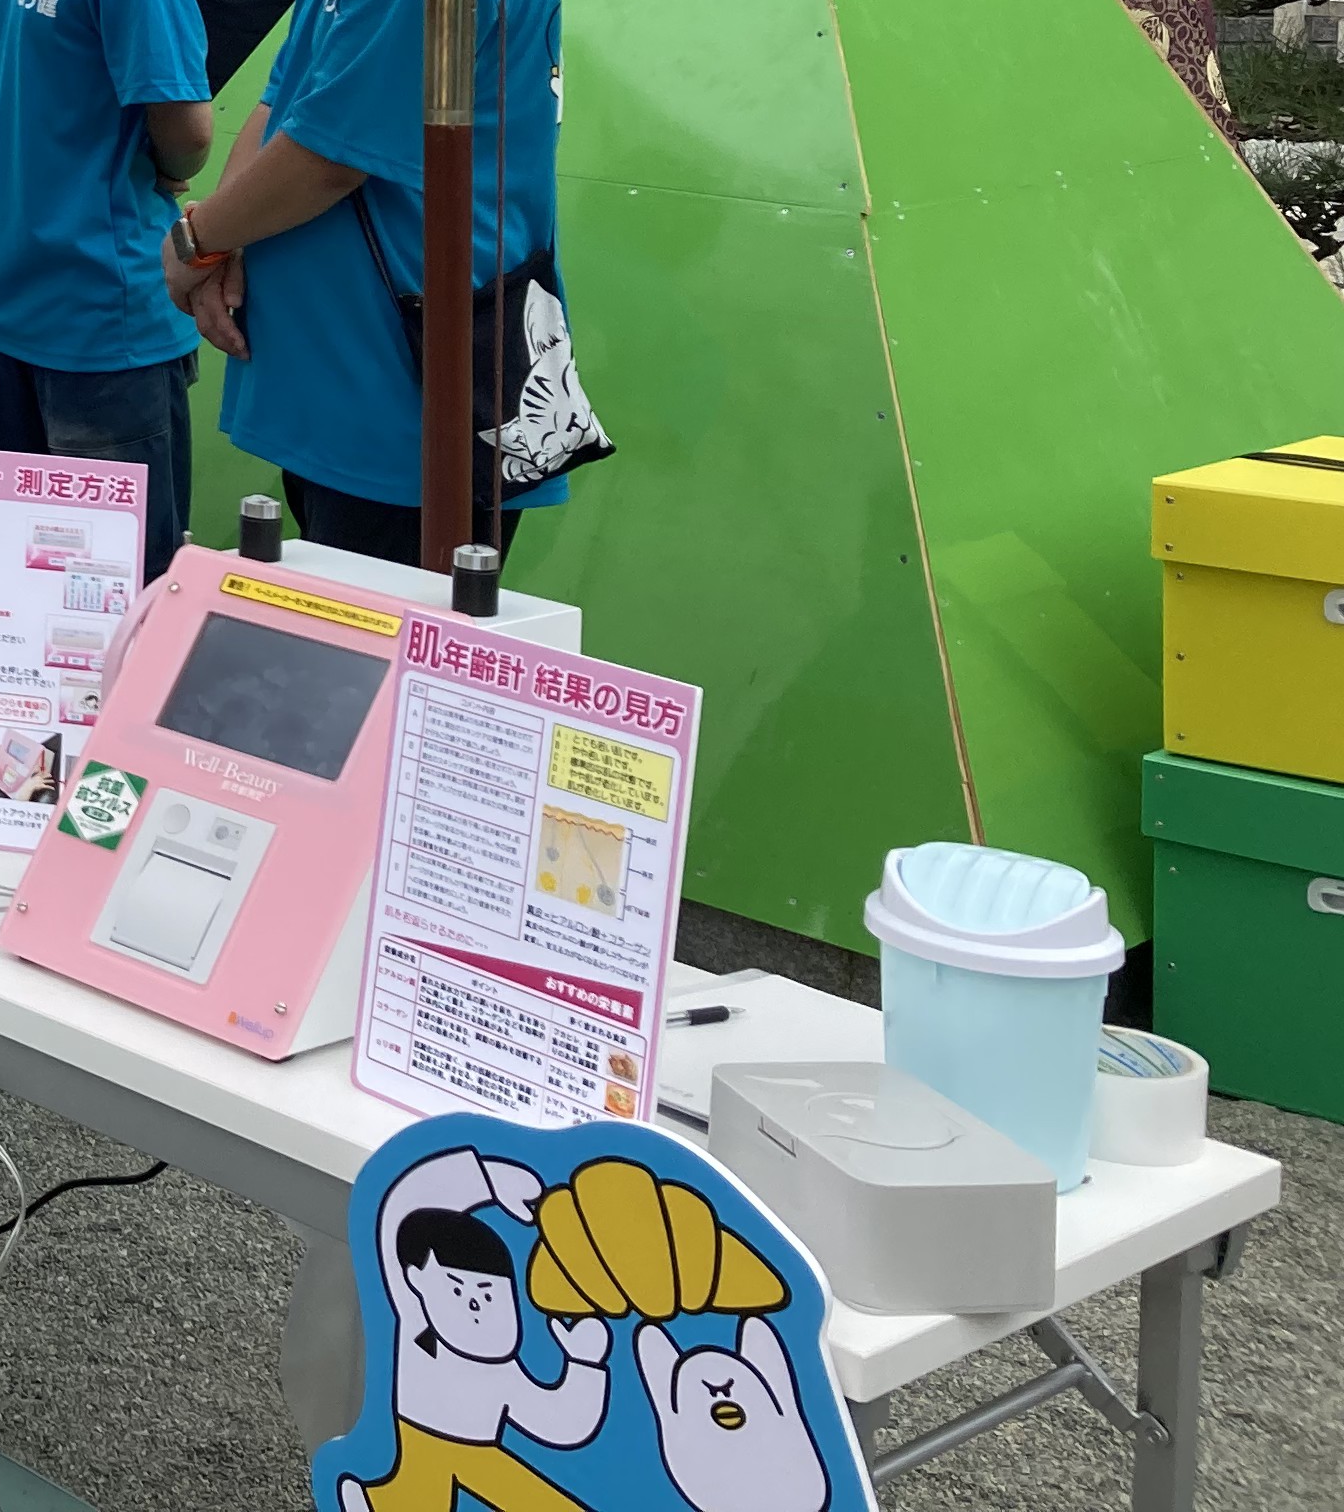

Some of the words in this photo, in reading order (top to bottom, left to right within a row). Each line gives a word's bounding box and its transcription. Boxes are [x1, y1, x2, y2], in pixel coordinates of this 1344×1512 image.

[14, 467, 138, 506] 測定方法
[406, 620, 526, 692] 肌年齢計
[534, 663, 686, 737] 結果の見方
